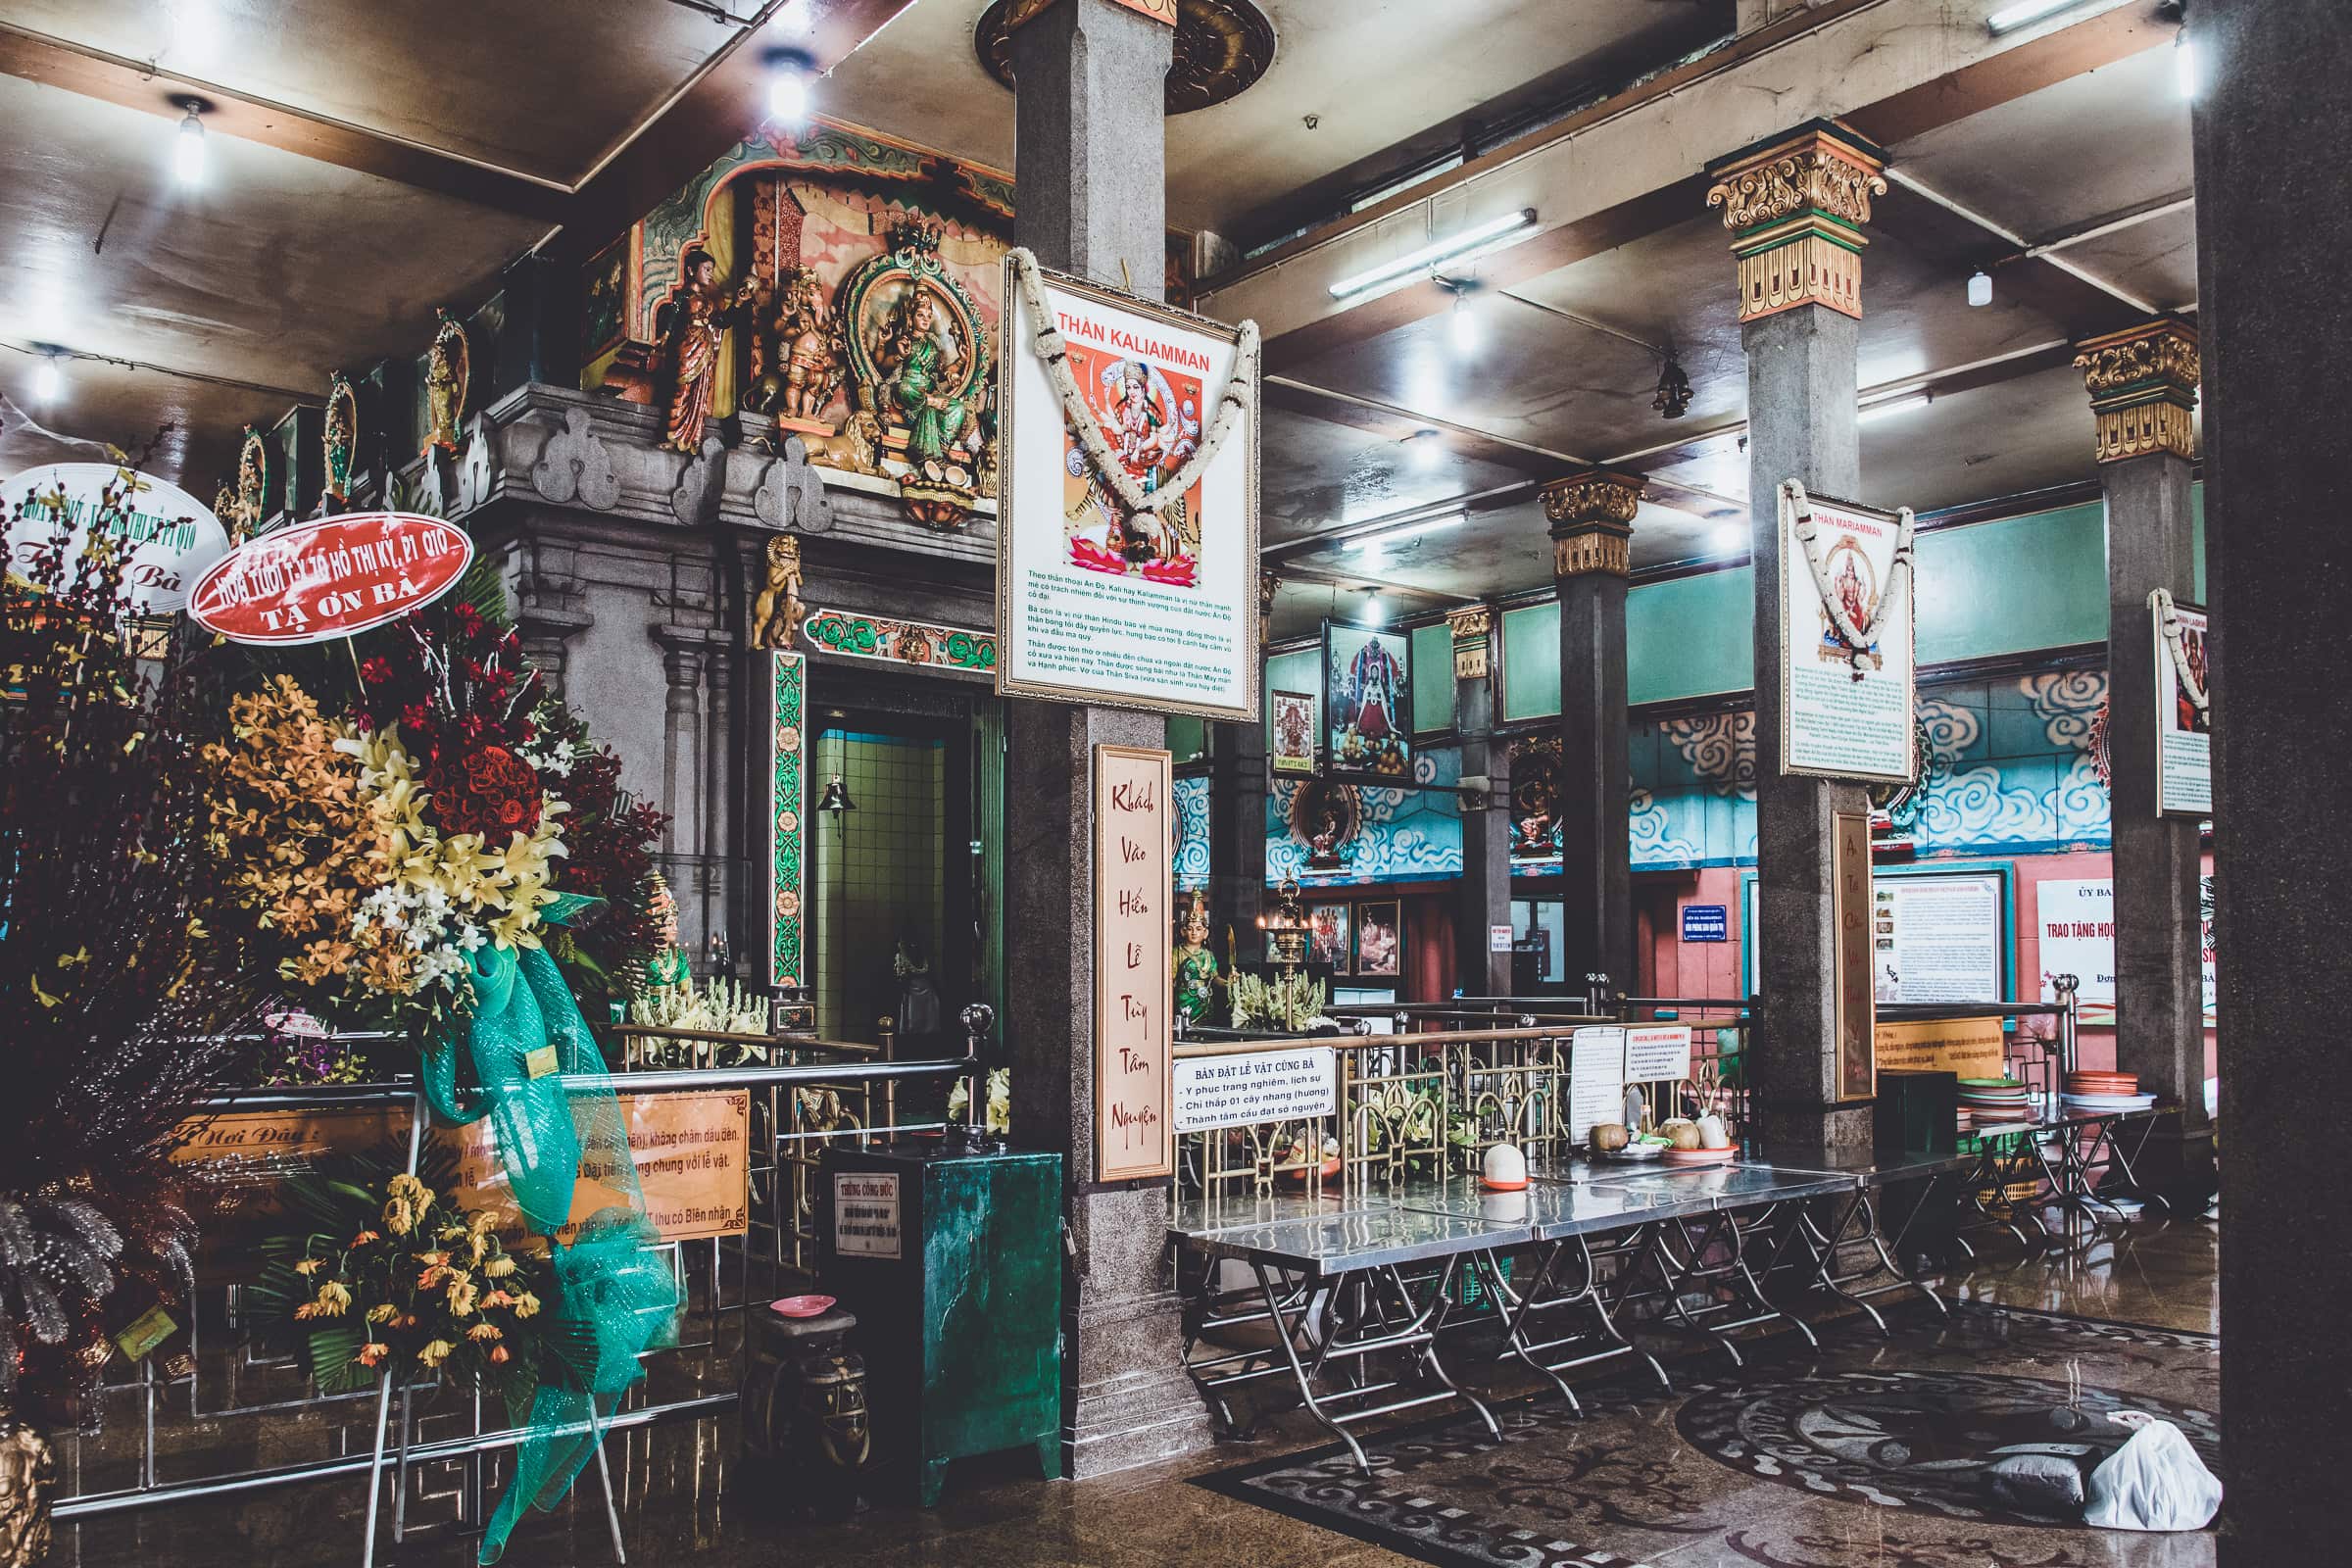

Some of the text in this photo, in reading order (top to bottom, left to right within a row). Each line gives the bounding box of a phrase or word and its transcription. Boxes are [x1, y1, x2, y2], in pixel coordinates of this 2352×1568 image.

[1110, 328, 1209, 372] KALIAMMAN
[1837, 516, 1883, 537] MARIAMMAN
[329, 538, 351, 581] HỒ
[351, 543, 379, 576] THỊ
[402, 534, 418, 564] P1
[422, 528, 448, 557] Q10
[1028, 569, 1046, 578] Theo
[1137, 589, 1172, 601] Kaliamman
[260, 570, 420, 632] TẠ ƠN BÀ
[1102, 616, 1122, 625] Hindu
[1124, 671, 1138, 680] Siva
[2079, 886, 2094, 897] ỦY
[2047, 923, 2069, 938] TRAO
[2072, 920, 2095, 941] TẶNG
[1111, 782, 1158, 1151] Khách Vào Hiến Lễ Tùy Tâm Nguyện
[1196, 1066, 1215, 1080] BÀN
[1217, 1065, 1236, 1080] ĐẶT
[1254, 1063, 1272, 1074] VẬT
[1223, 1082, 1248, 1093] trang
[1291, 1076, 1307, 1087] lịch
[1230, 1097, 1240, 1105] 01
[1262, 1091, 1292, 1102] nhang
[1294, 1088, 1331, 1100] (hương)
[1220, 1112, 1238, 1121] tâm
[1260, 1106, 1275, 1117] đạt
[1292, 1102, 1325, 1114] nguyện
[654, 1158, 683, 1175] chung
[685, 1207, 706, 1223] Biên
[708, 1206, 731, 1222] nhận
